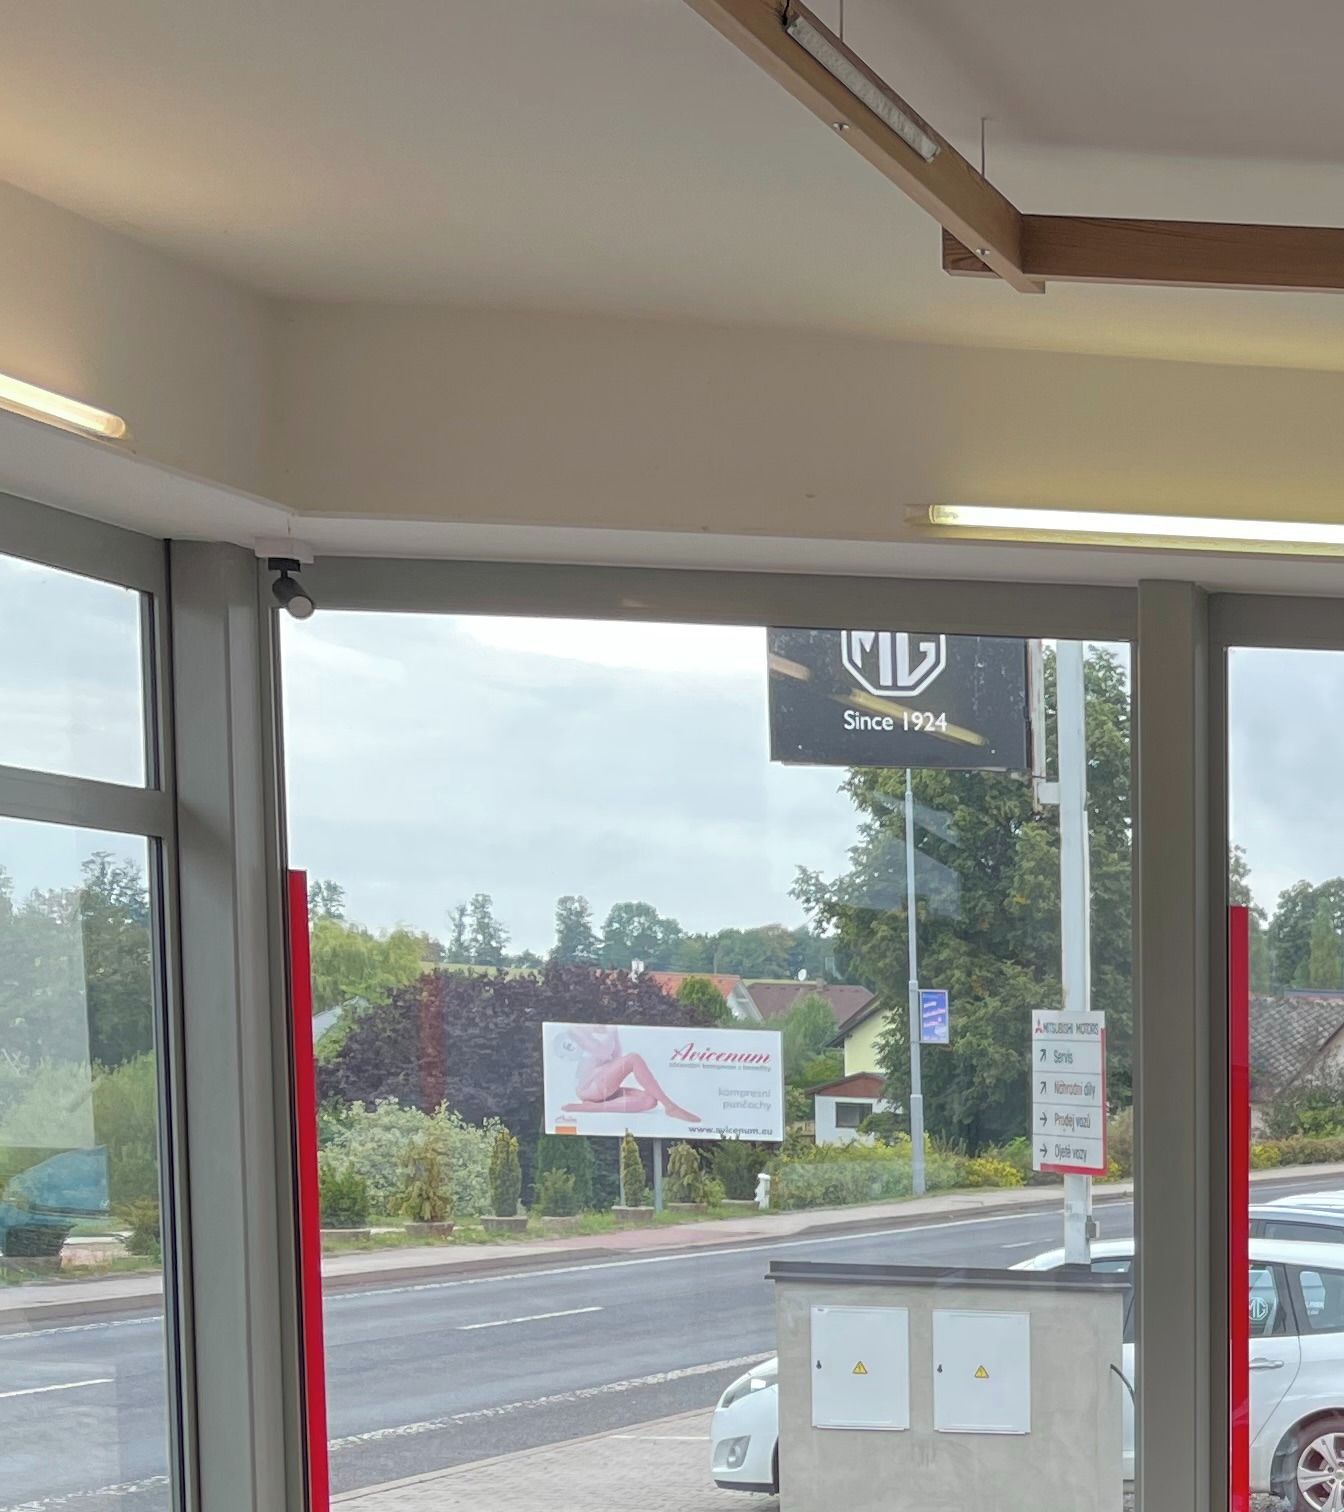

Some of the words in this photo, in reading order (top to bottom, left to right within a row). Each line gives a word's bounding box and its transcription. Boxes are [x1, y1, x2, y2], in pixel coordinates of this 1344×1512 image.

[851, 631, 936, 687] MG
[843, 710, 894, 731] Since
[903, 711, 948, 732] 1924
[671, 1042, 770, 1064] Avicenum
[1053, 1049, 1074, 1065] Servis
